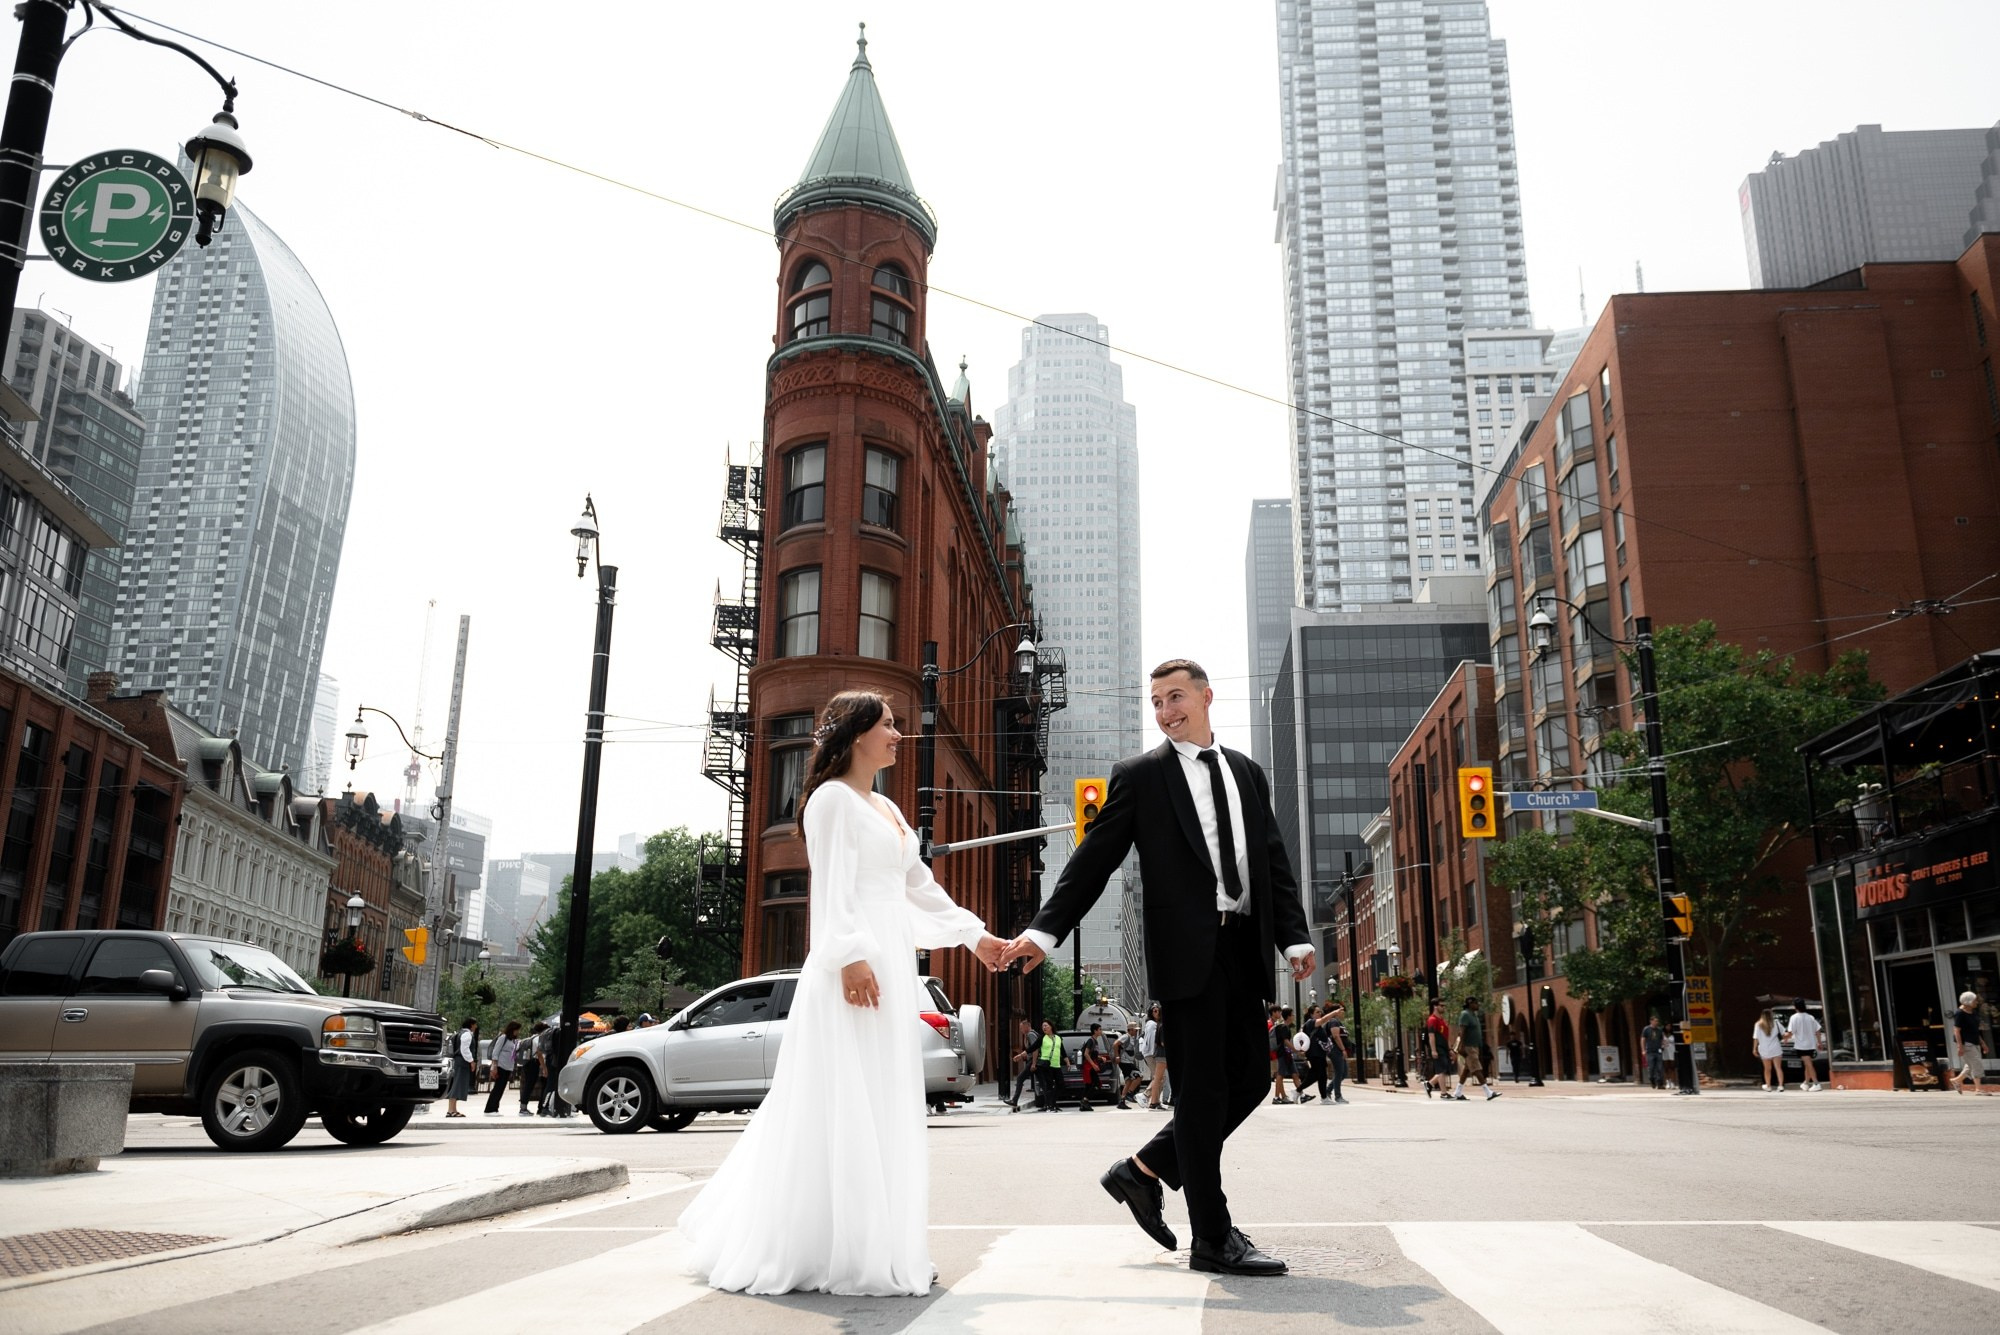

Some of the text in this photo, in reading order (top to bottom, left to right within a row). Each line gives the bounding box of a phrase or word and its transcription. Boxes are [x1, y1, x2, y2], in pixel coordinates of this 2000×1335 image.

[49, 155, 187, 211] MUNICIPAL
[90, 182, 151, 234] P
[46, 225, 183, 278] PARKING
[1527, 793, 1580, 806] Church St
[497, 860, 521, 872] pwc
[1911, 851, 1989, 881] CRAFT BURGERS & BEER
[1855, 873, 1910, 908] WORKS
[1686, 979, 1709, 990] ARK
[1687, 991, 1711, 1004] ERE
[409, 1031, 431, 1042] GMC
